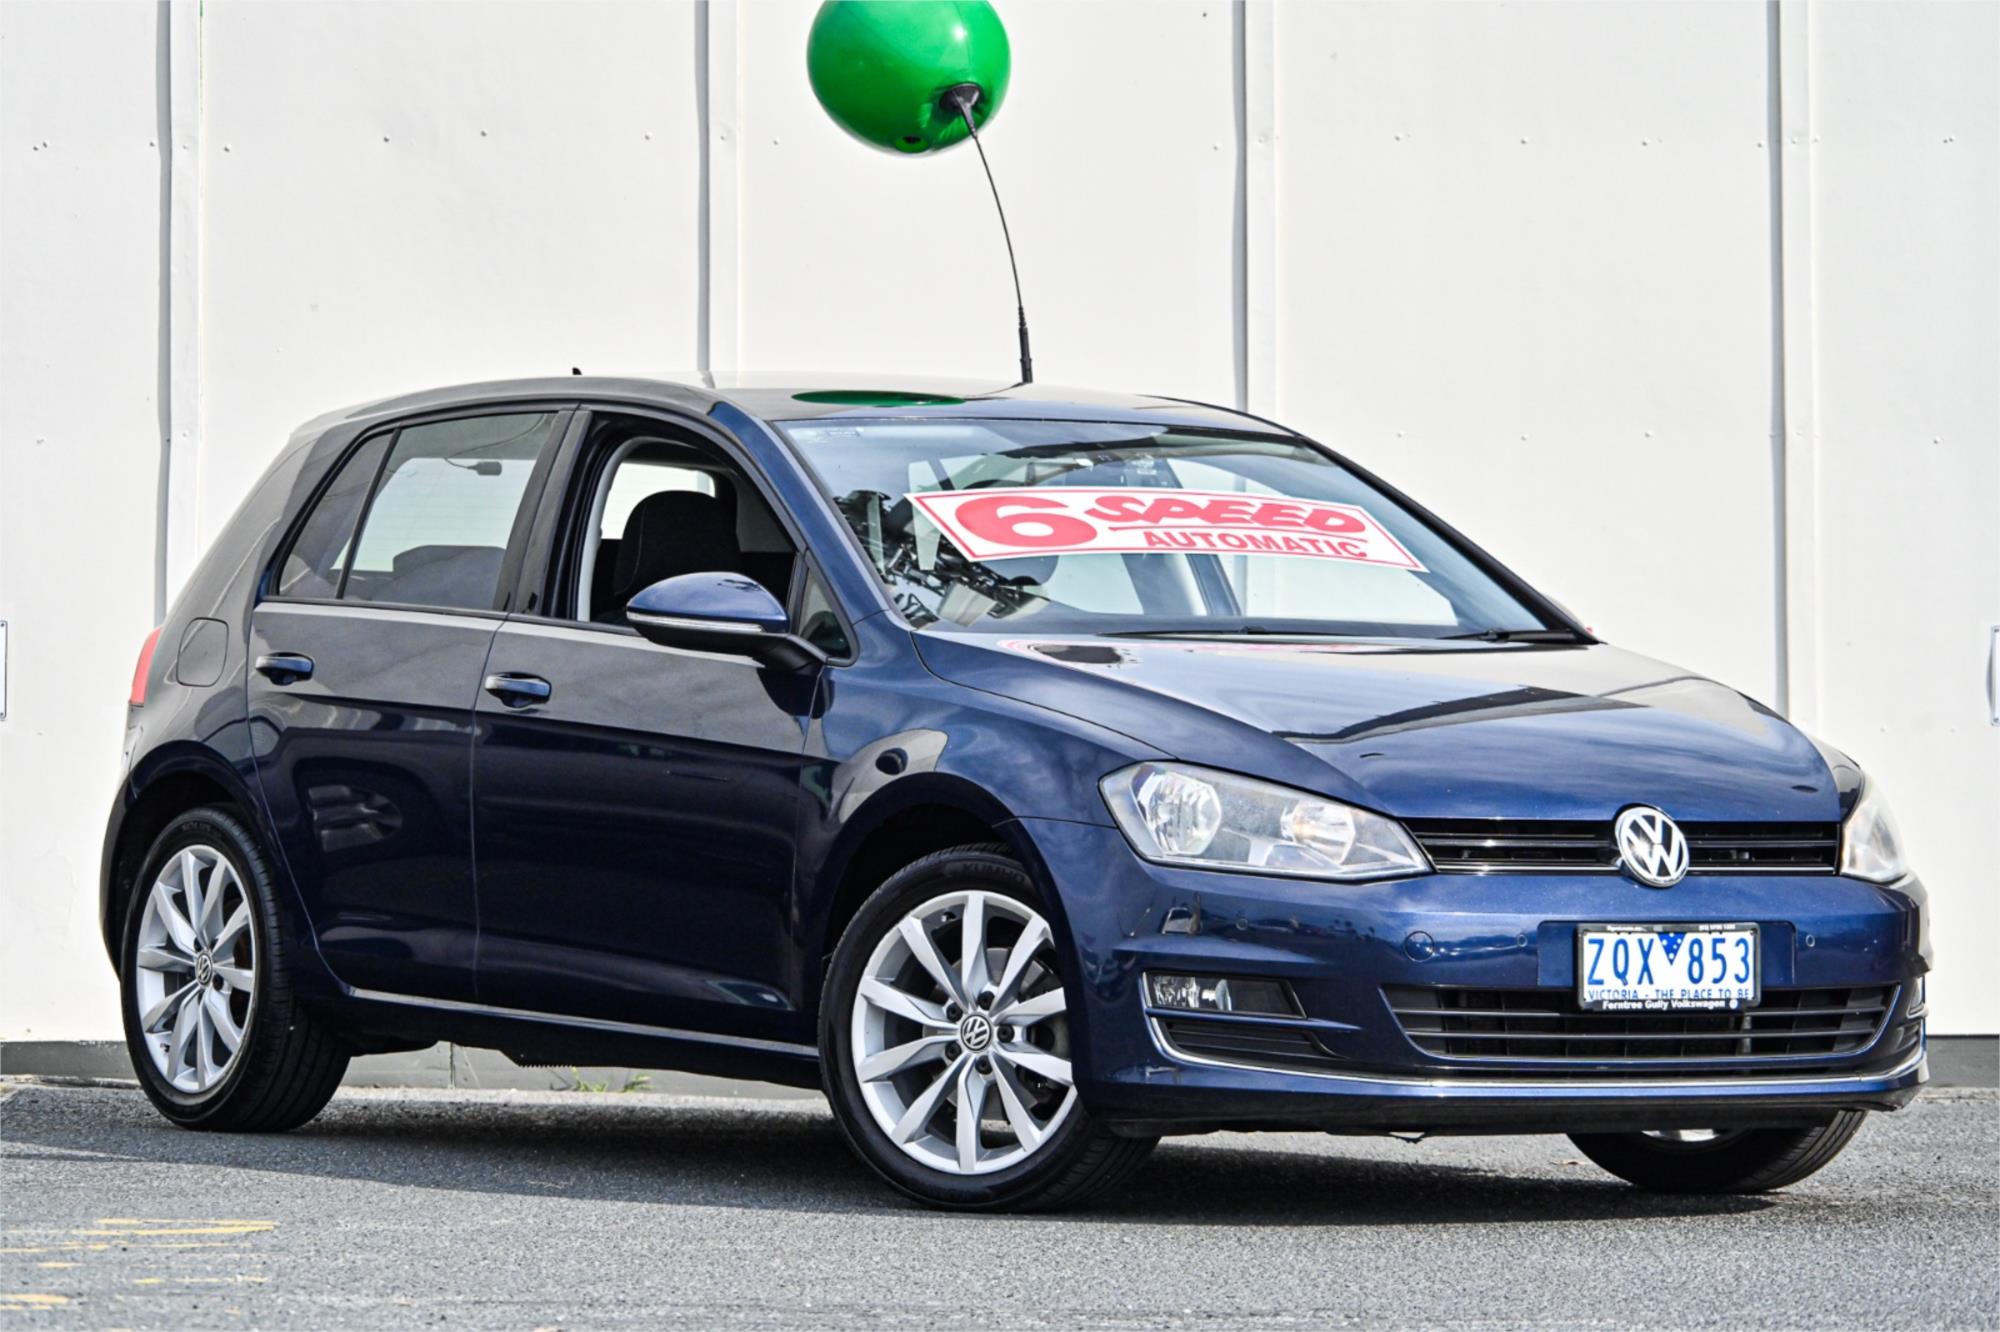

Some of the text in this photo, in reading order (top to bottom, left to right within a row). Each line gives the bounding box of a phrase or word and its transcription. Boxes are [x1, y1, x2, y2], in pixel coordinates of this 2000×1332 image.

[955, 495, 1364, 547] 6 SPEED
[1145, 531, 1367, 557] AUTOMATIC
[963, 863, 1024, 882] KUMHO
[1587, 938, 1750, 986] ZQX 853
[1588, 989, 1638, 1000] VICTORIA
[1655, 989, 1674, 1000] THE
[1681, 989, 1712, 1000] PLACE
[1718, 989, 1731, 1000] TO
[1738, 989, 1749, 999] BE
[1602, 1000, 1643, 1009] Ferntree
[1645, 1000, 1669, 1010] Gully
[1671, 1000, 1725, 1009] Volkswagen
